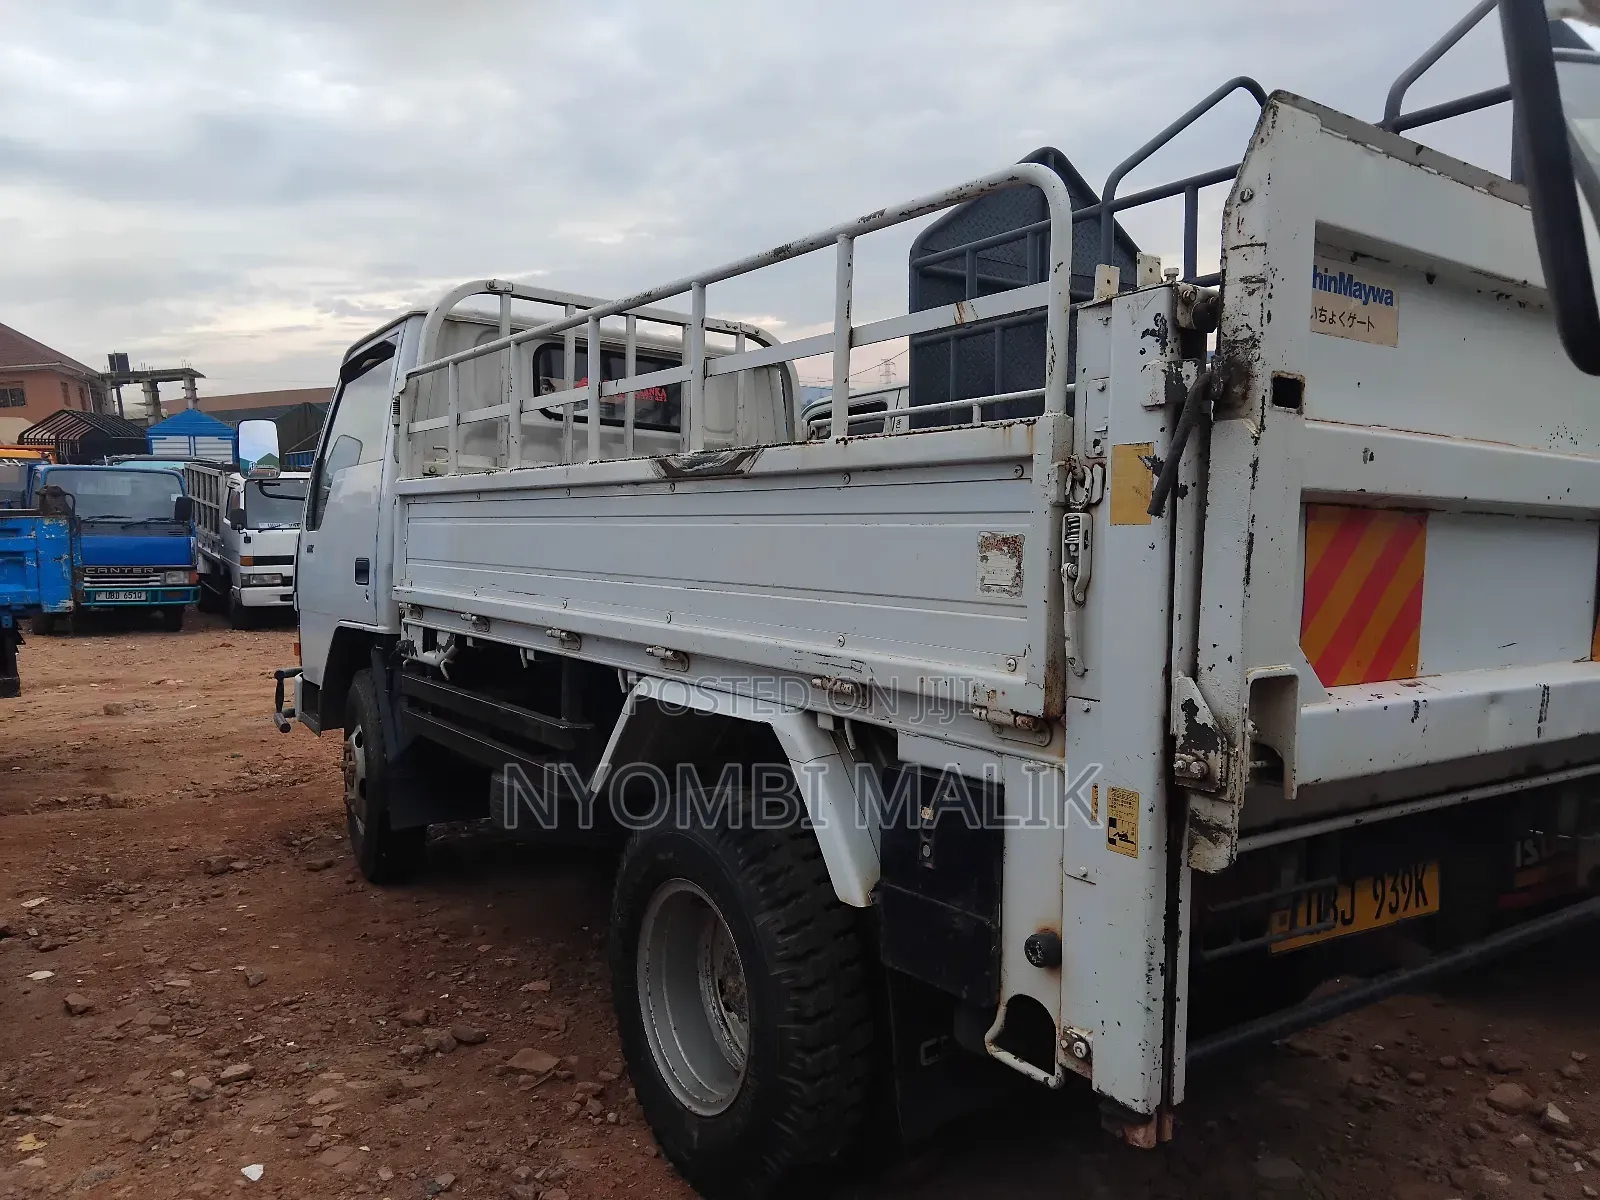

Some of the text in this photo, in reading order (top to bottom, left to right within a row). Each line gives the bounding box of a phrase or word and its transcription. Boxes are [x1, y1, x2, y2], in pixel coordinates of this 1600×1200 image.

[1313, 265, 1394, 306] hinMaywa
[1310, 306, 1375, 332] いちょくゲート
[1373, 865, 1429, 920] 939K
